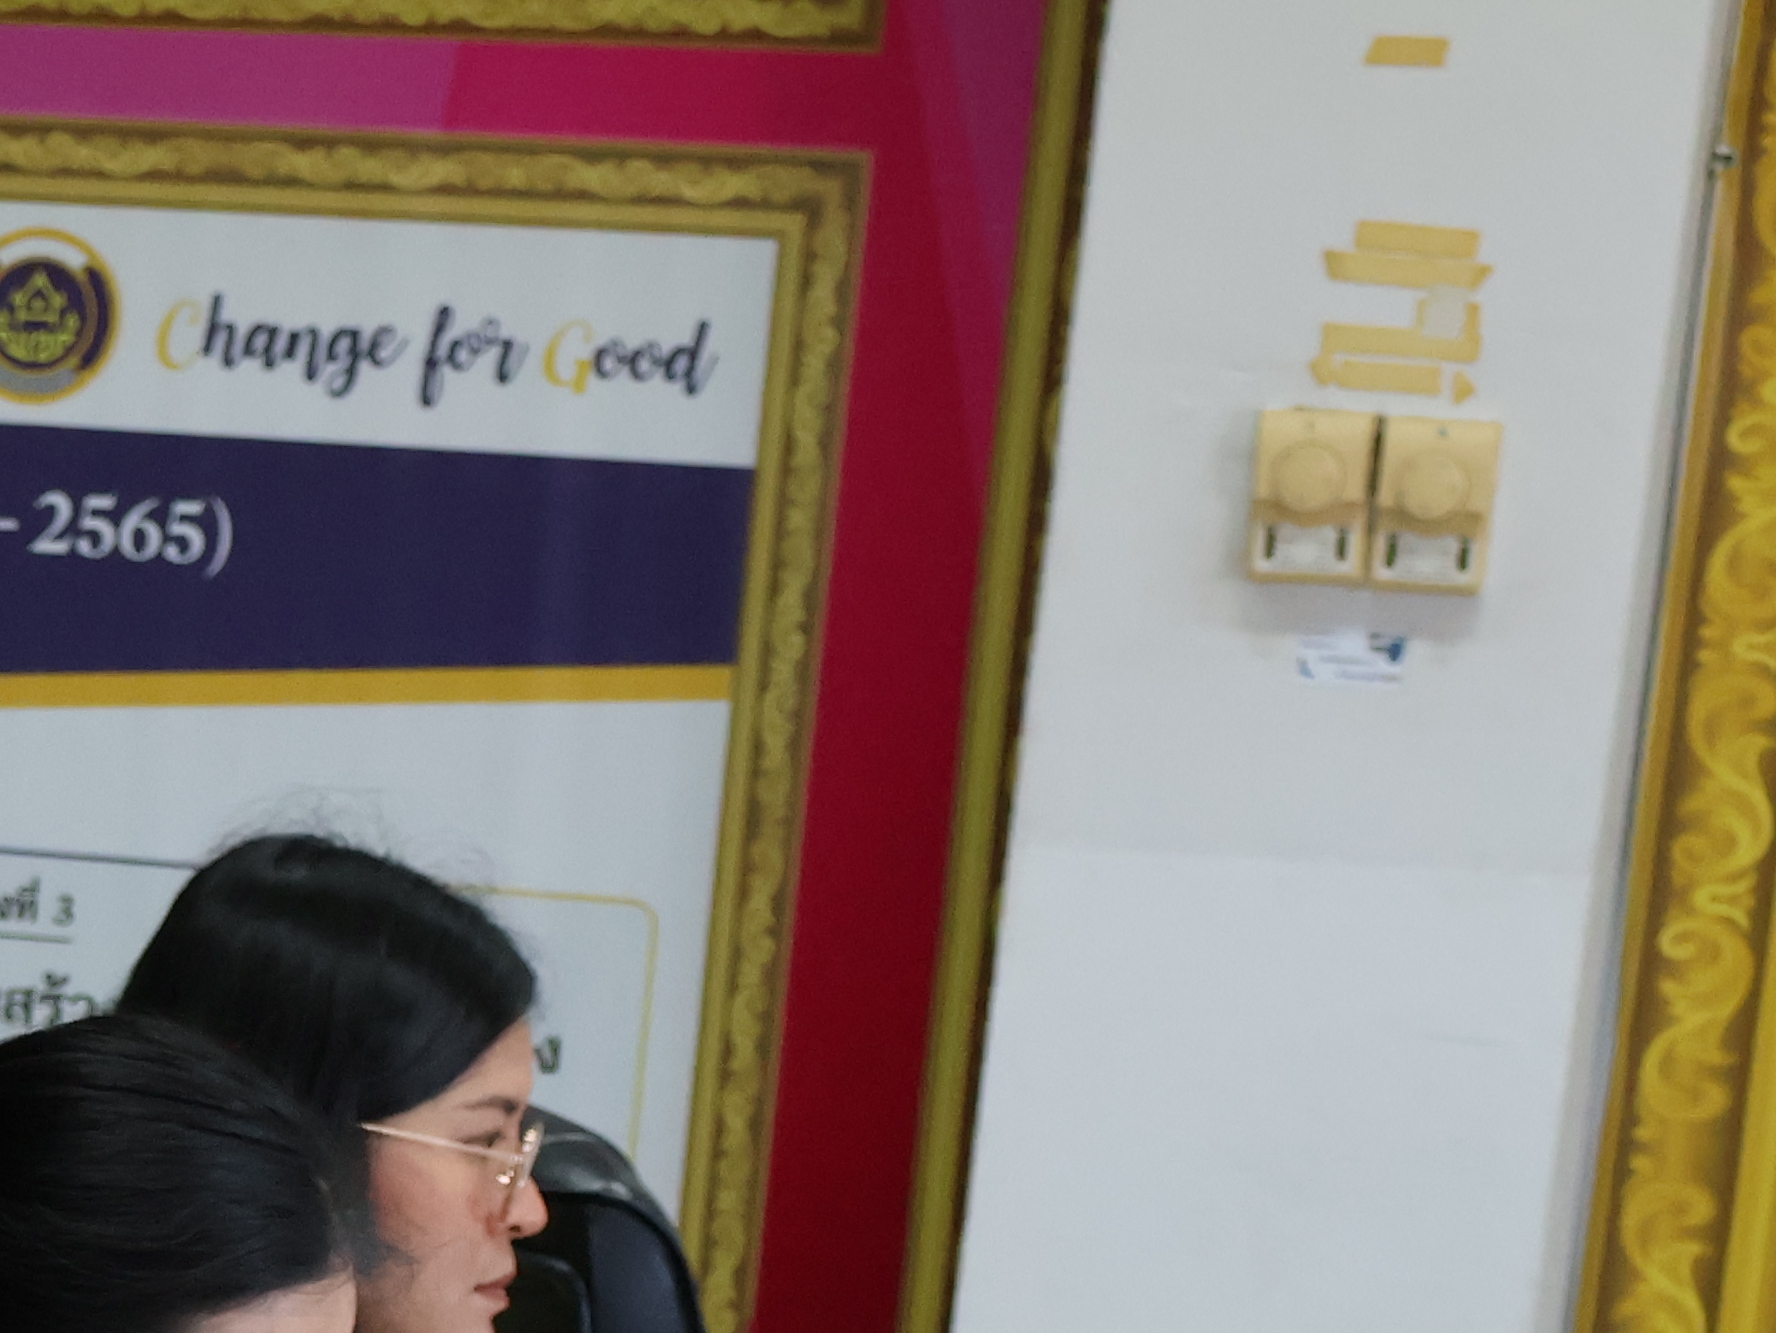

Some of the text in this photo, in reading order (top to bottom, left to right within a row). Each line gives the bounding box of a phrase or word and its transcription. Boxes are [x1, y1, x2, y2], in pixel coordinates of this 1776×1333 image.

[156, 294, 715, 407] Change for Good
[52, 895, 75, 926] 3
